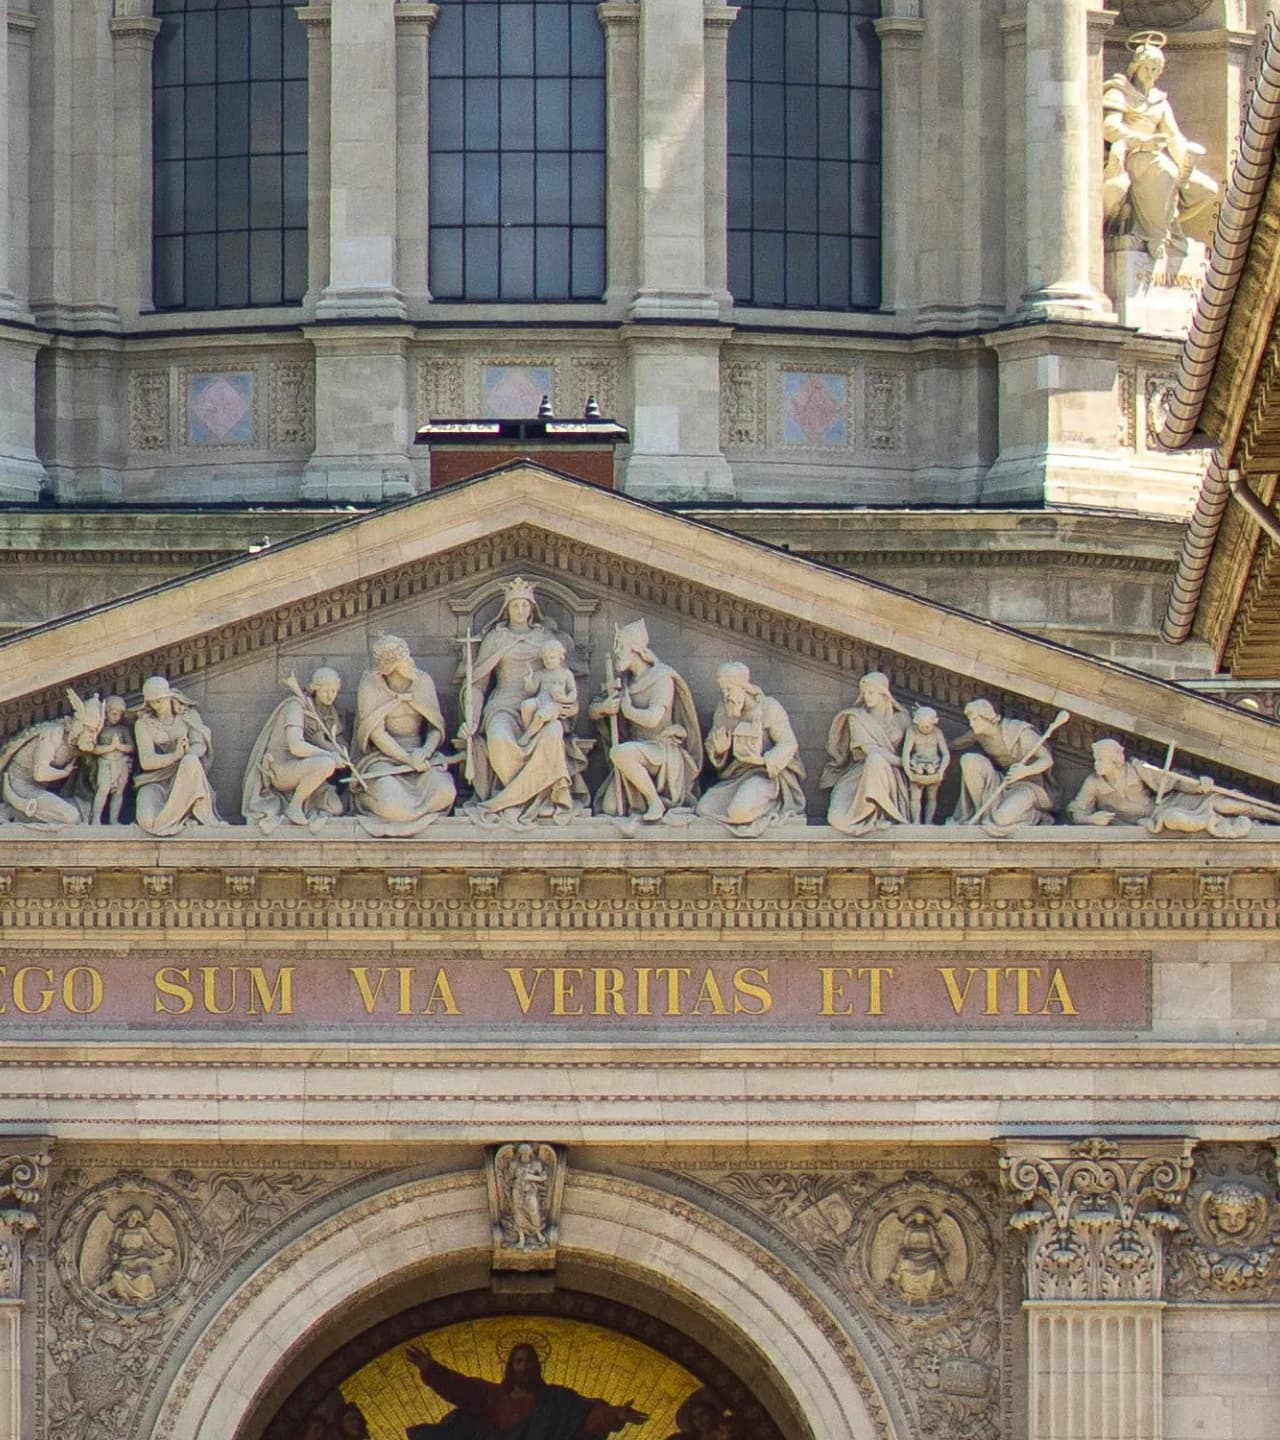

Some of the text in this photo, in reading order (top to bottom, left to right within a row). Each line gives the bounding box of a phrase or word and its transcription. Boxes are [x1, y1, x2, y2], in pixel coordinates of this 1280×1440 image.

[153, 965, 295, 1016] SUM
[350, 965, 461, 1016] VIA
[504, 965, 776, 1017] VERITAS
[819, 965, 896, 1016] ET
[937, 965, 1079, 1016] VITA
